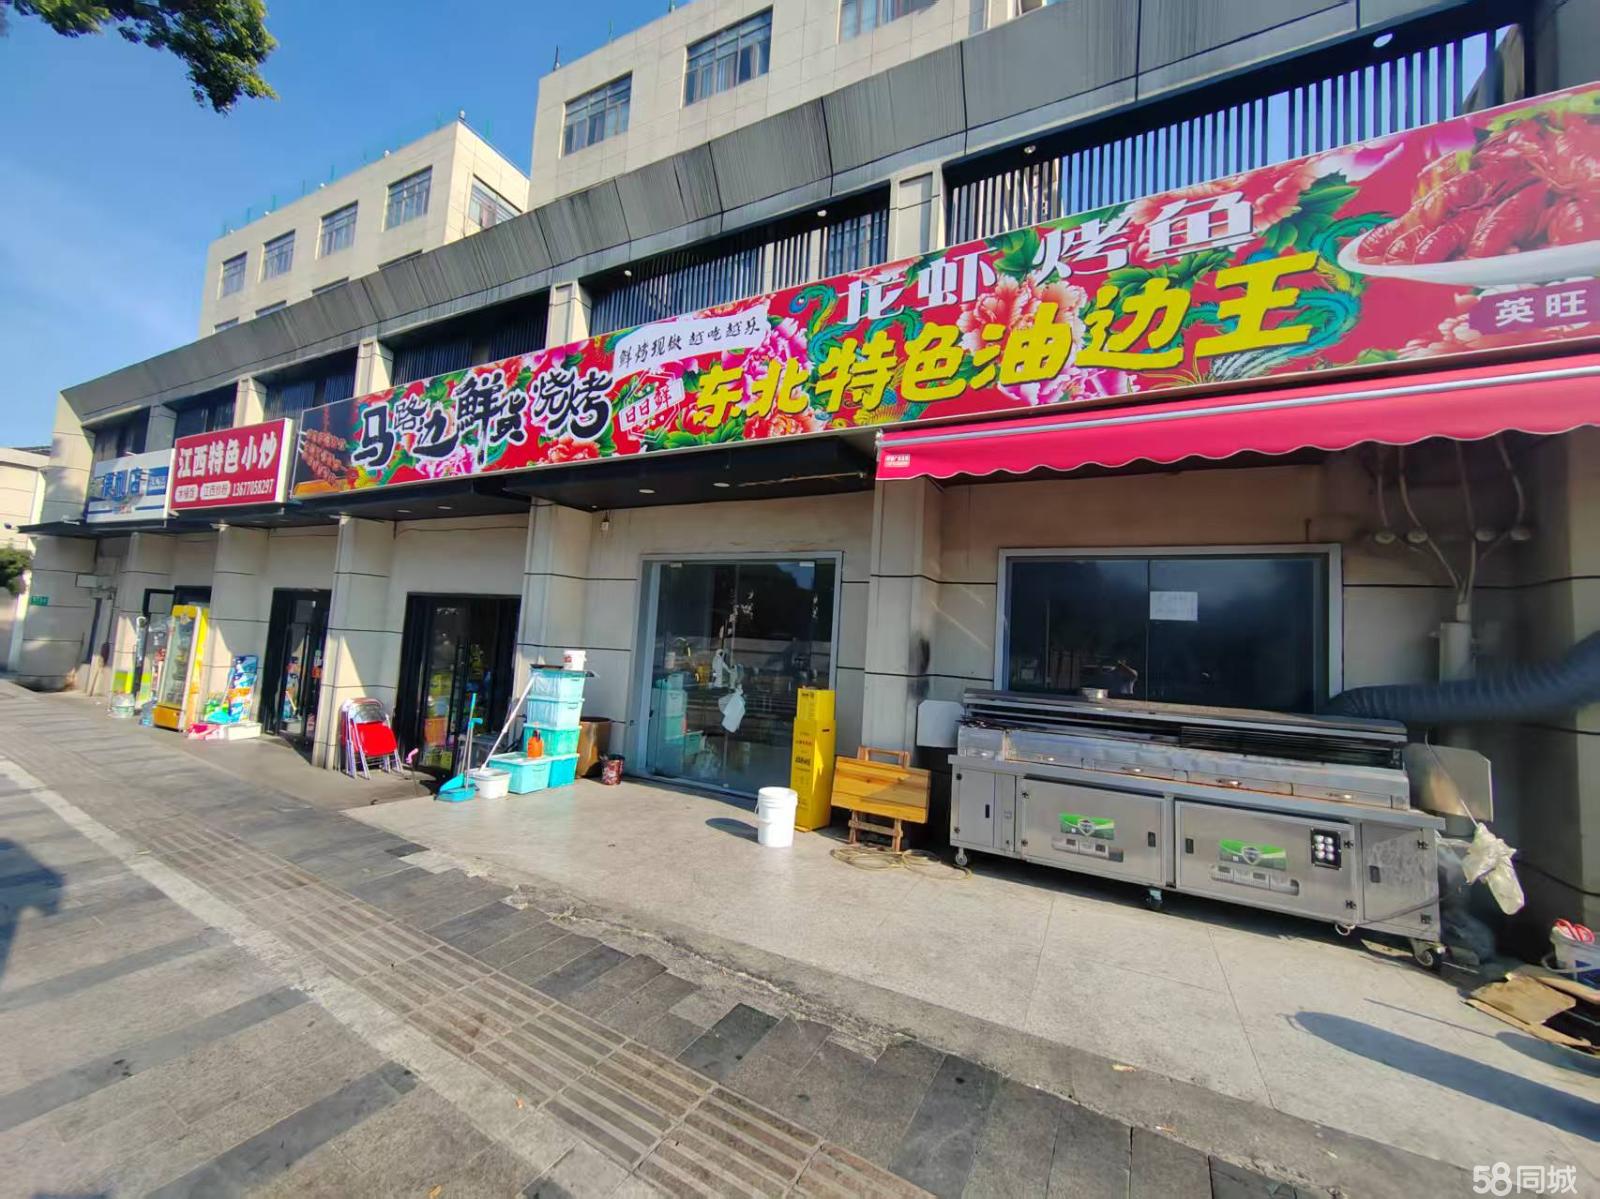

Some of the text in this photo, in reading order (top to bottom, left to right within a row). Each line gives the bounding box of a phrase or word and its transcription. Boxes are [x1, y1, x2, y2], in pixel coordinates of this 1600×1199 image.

[838, 191, 1257, 325] 龙虾 烤鱼
[692, 251, 1320, 429] 东北特色油边王
[1495, 289, 1588, 327] 英旺
[351, 371, 613, 466] 马路边鲜货烧烤
[625, 385, 672, 424] 日日鲜
[177, 431, 277, 478] 江西特色小炒
